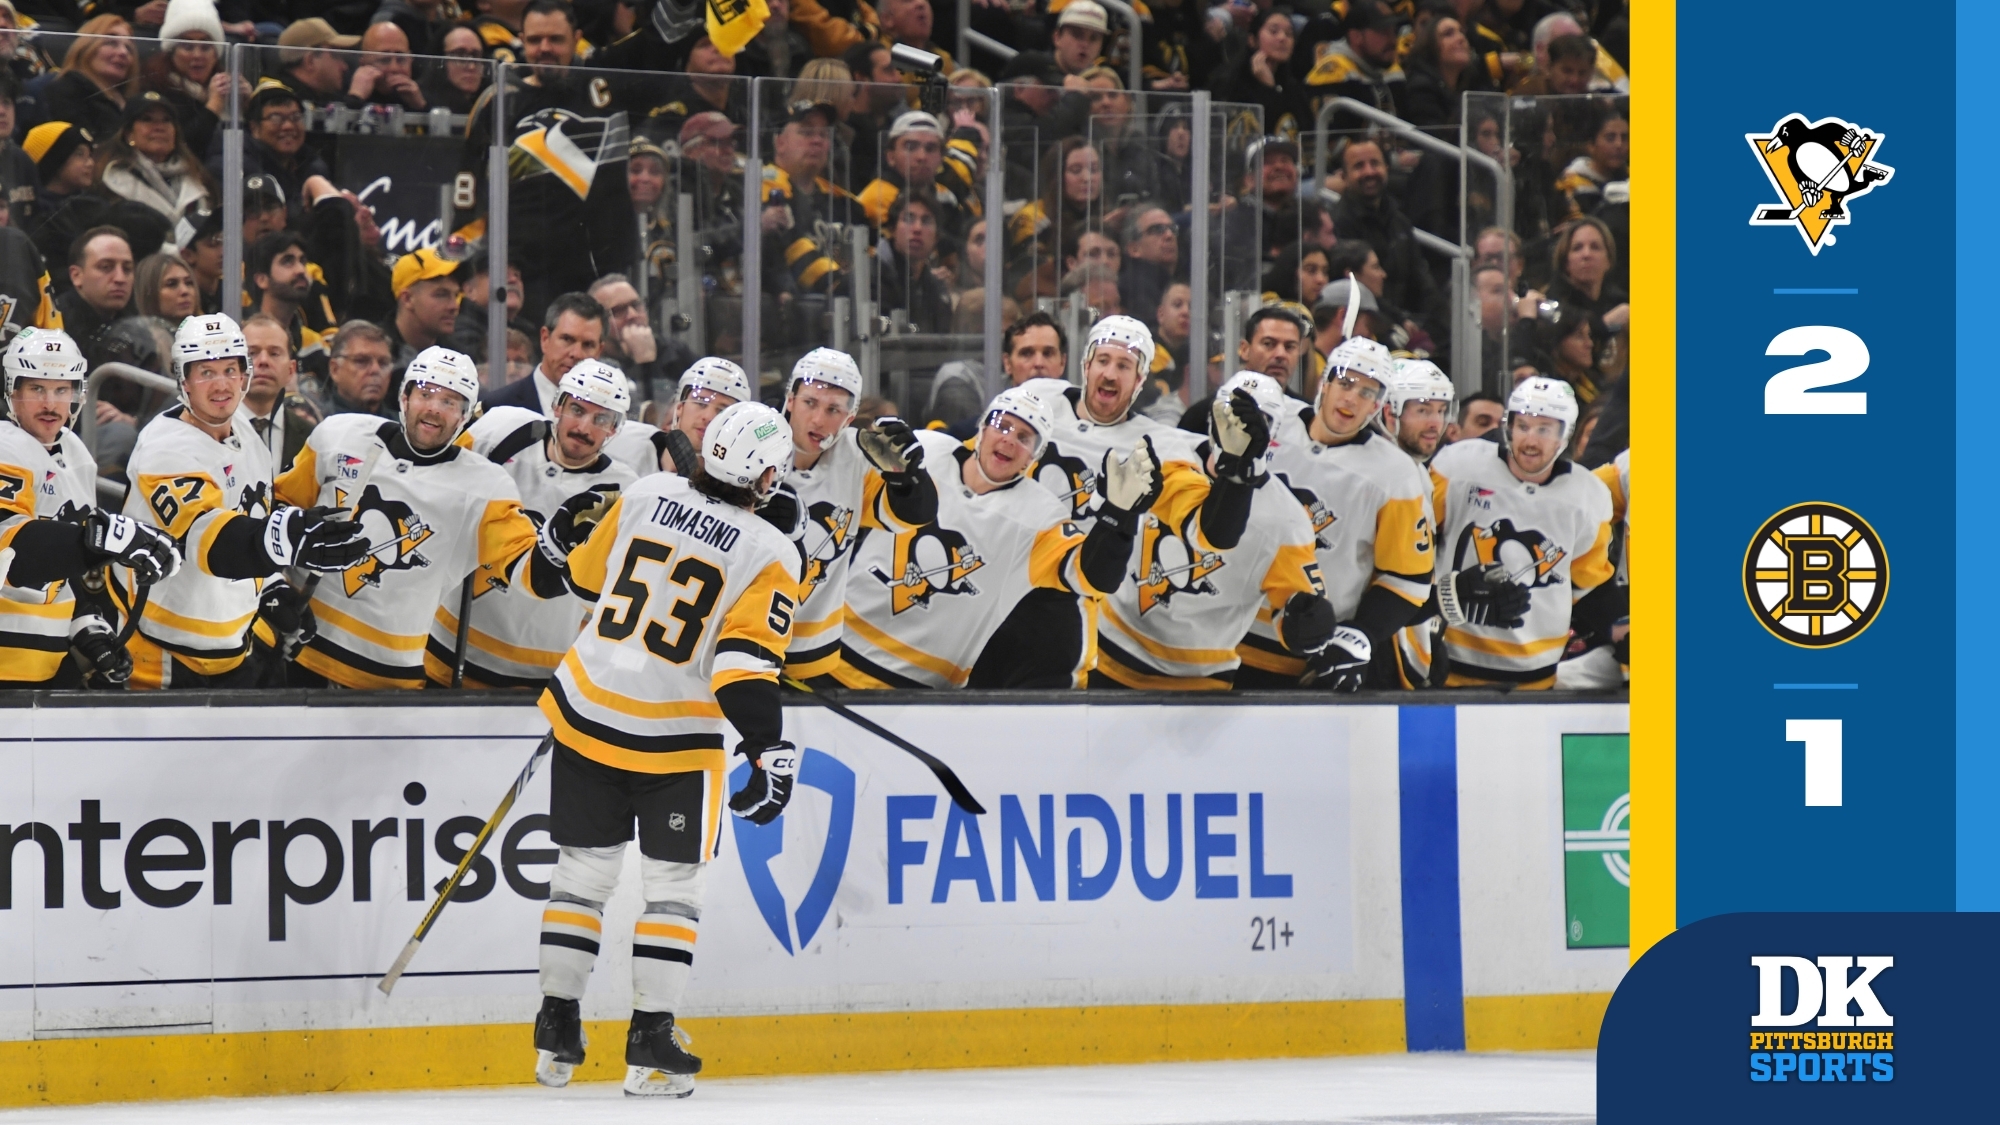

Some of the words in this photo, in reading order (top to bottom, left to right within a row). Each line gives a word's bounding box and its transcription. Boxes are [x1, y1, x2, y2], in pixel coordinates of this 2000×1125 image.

[589, 77, 611, 108] C
[453, 171, 476, 209] 8
[205, 321, 221, 331] 67
[45, 342, 61, 352] 87
[712, 443, 728, 460] 53
[149, 475, 206, 529] 67
[650, 495, 741, 553] TOMASINO
[597, 535, 727, 667] 53
[0, 781, 560, 942] nterprise
[886, 792, 1293, 905] FANDUEL
[1251, 916, 1294, 951] 21+
